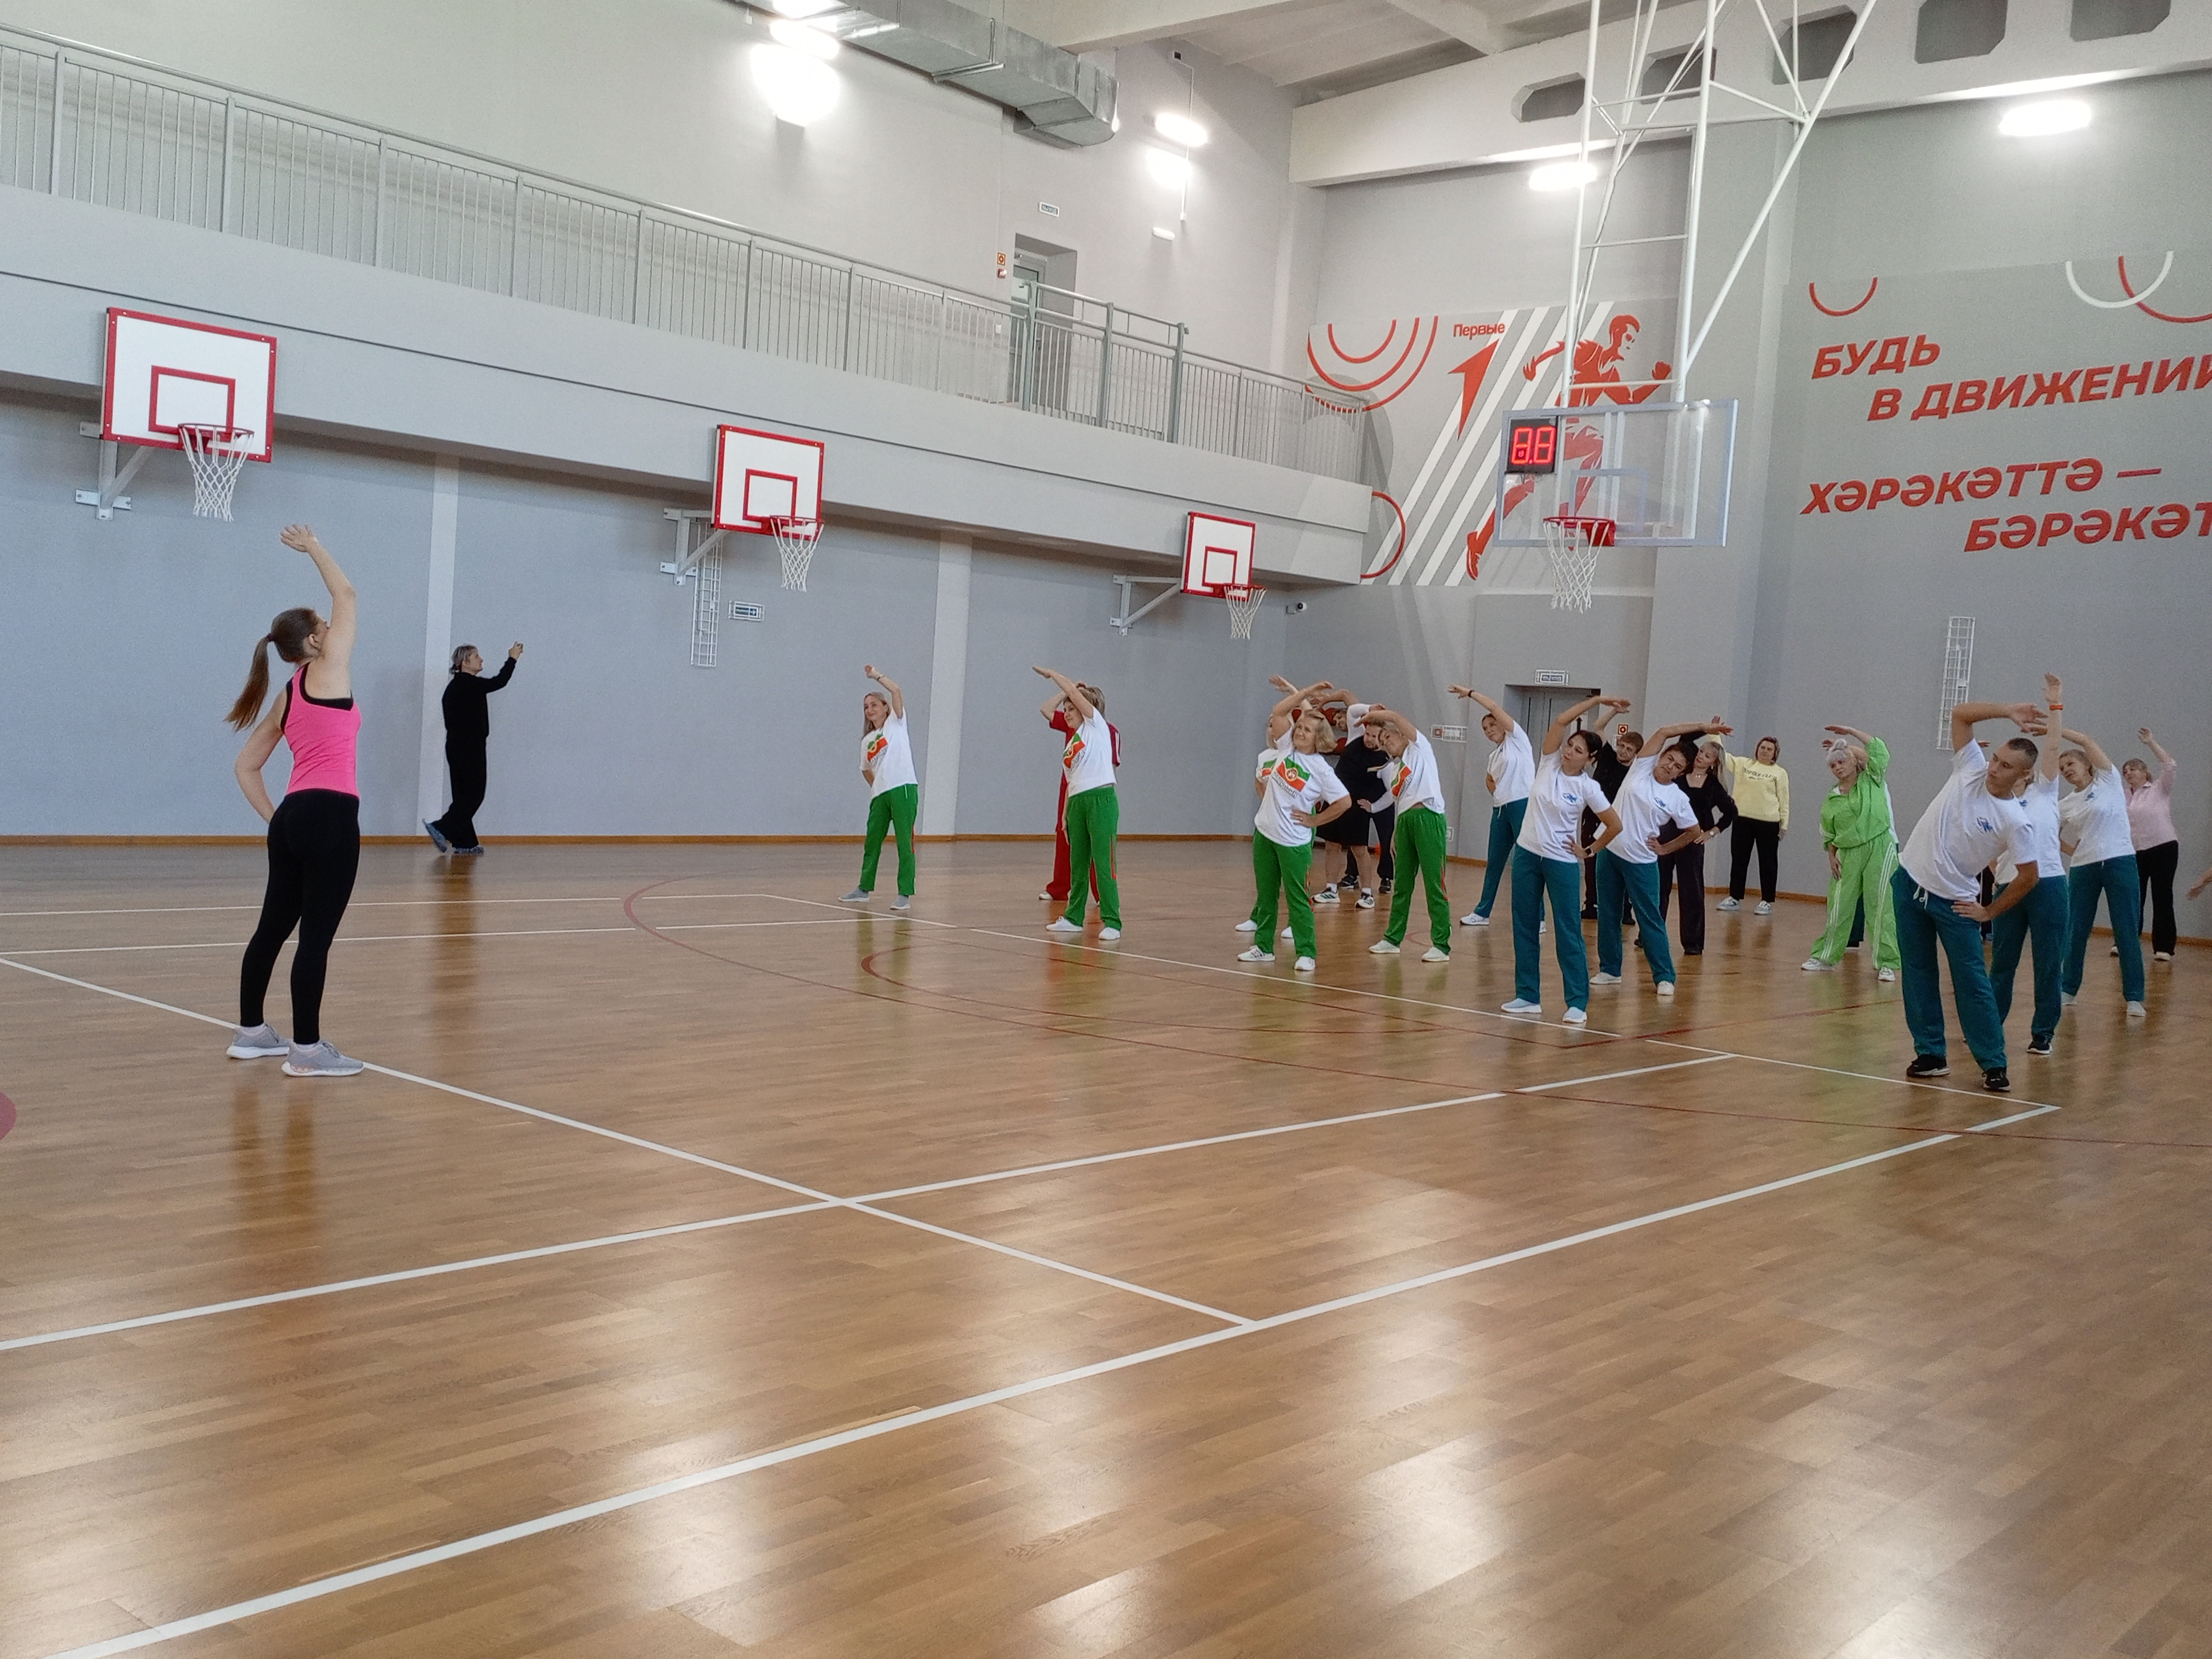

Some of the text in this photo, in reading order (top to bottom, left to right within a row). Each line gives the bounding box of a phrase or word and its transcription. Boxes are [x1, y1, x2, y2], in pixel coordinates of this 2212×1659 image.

[1453, 323, 1505, 339] Первые
[1812, 334, 1941, 379] БУДЬ
[1867, 388, 1902, 421] В
[1801, 457, 2104, 515] ХӘРӘКӘТТӘ
